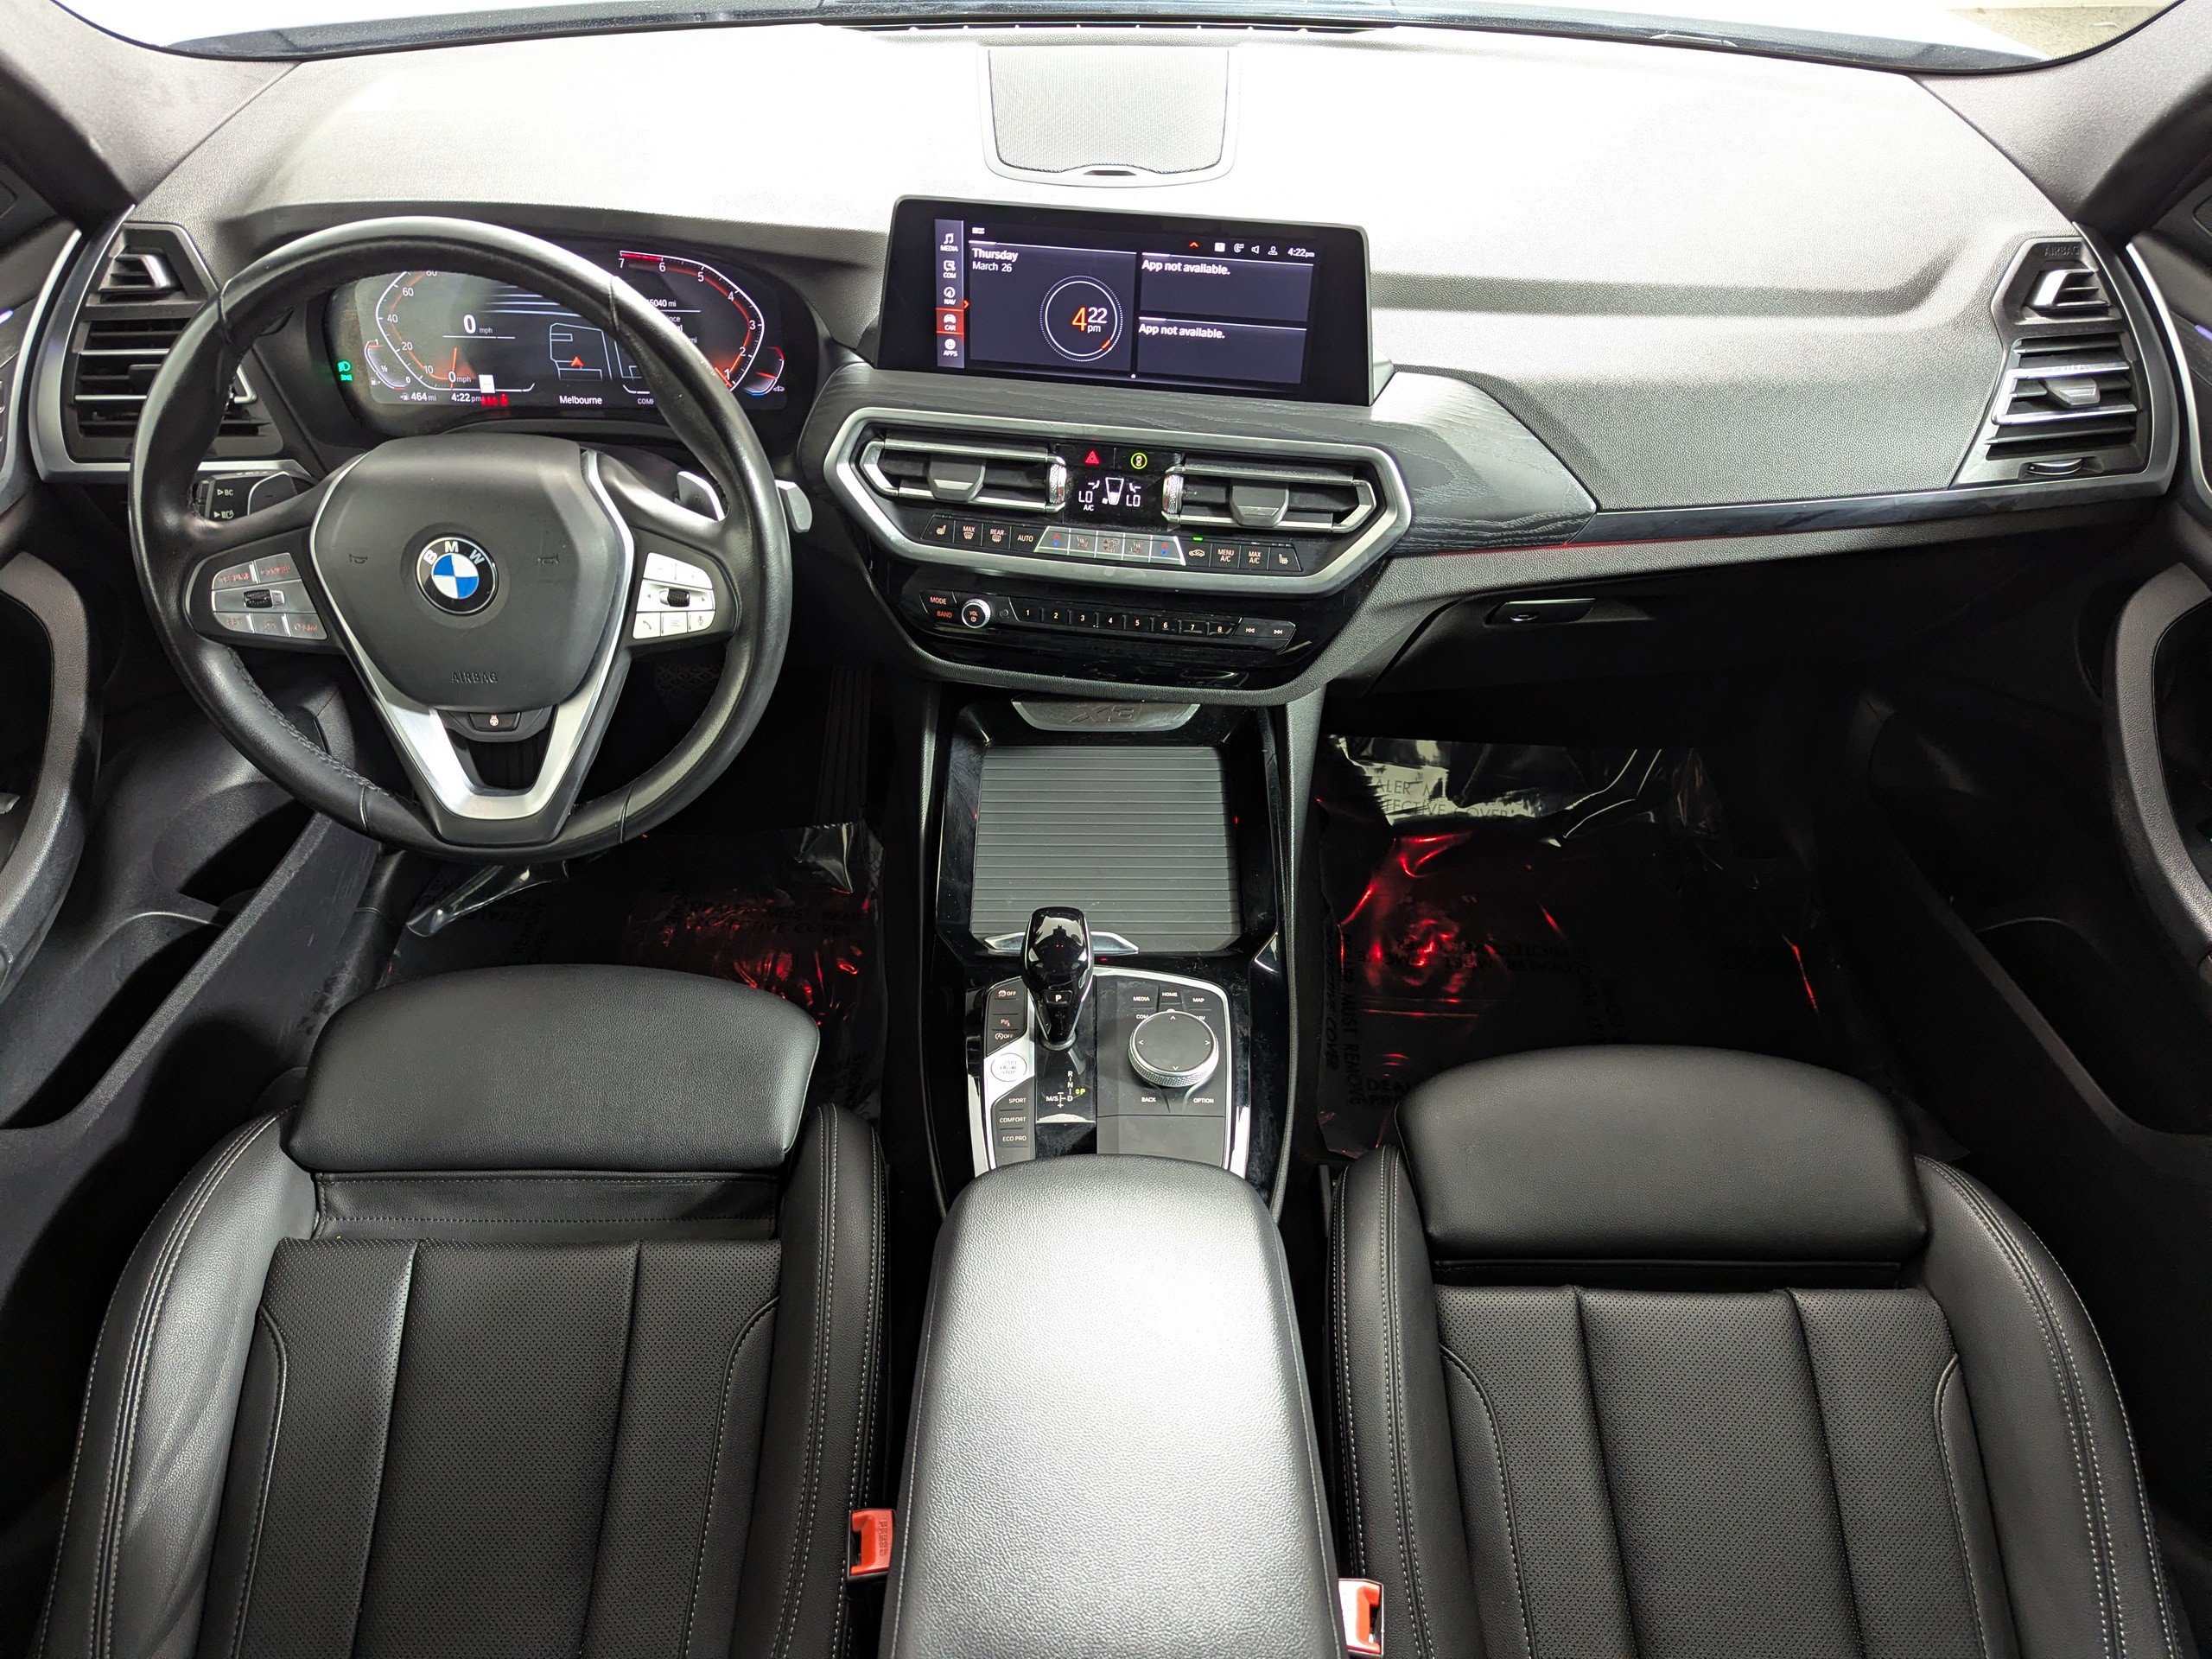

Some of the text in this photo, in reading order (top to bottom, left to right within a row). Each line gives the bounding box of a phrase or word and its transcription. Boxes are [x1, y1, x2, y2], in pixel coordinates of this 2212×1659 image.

[971, 248, 1019, 262] Thursday
[1287, 246, 1315, 258] 4:22pm
[658, 261, 666, 272] 6
[971, 261, 1013, 272] March 26
[1141, 259, 1231, 276] App not available.
[696, 271, 705, 283] 5
[402, 287, 414, 297] 60
[727, 291, 734, 302] 4
[386, 314, 398, 324] 40
[462, 314, 493, 336] 0 mph
[748, 320, 757, 331] 3
[944, 323, 957, 332] CAR
[1087, 325, 1102, 334] pm
[1138, 323, 1226, 339] App not available.
[401, 341, 413, 351] 20
[738, 346, 747, 357] 2
[943, 349, 958, 358] APPS
[423, 365, 434, 375] 10
[410, 391, 428, 402] 464
[559, 395, 603, 405] Melbourne
[224, 488, 234, 497] BC
[1078, 490, 1093, 504] LO
[1126, 494, 1141, 507] LO
[989, 528, 1005, 537] REAR
[1017, 534, 1034, 543] AUTO
[423, 540, 486, 565] BMW
[930, 595, 947, 605] MODE
[937, 609, 953, 620] BAND
[451, 671, 498, 683] AIRBAG
